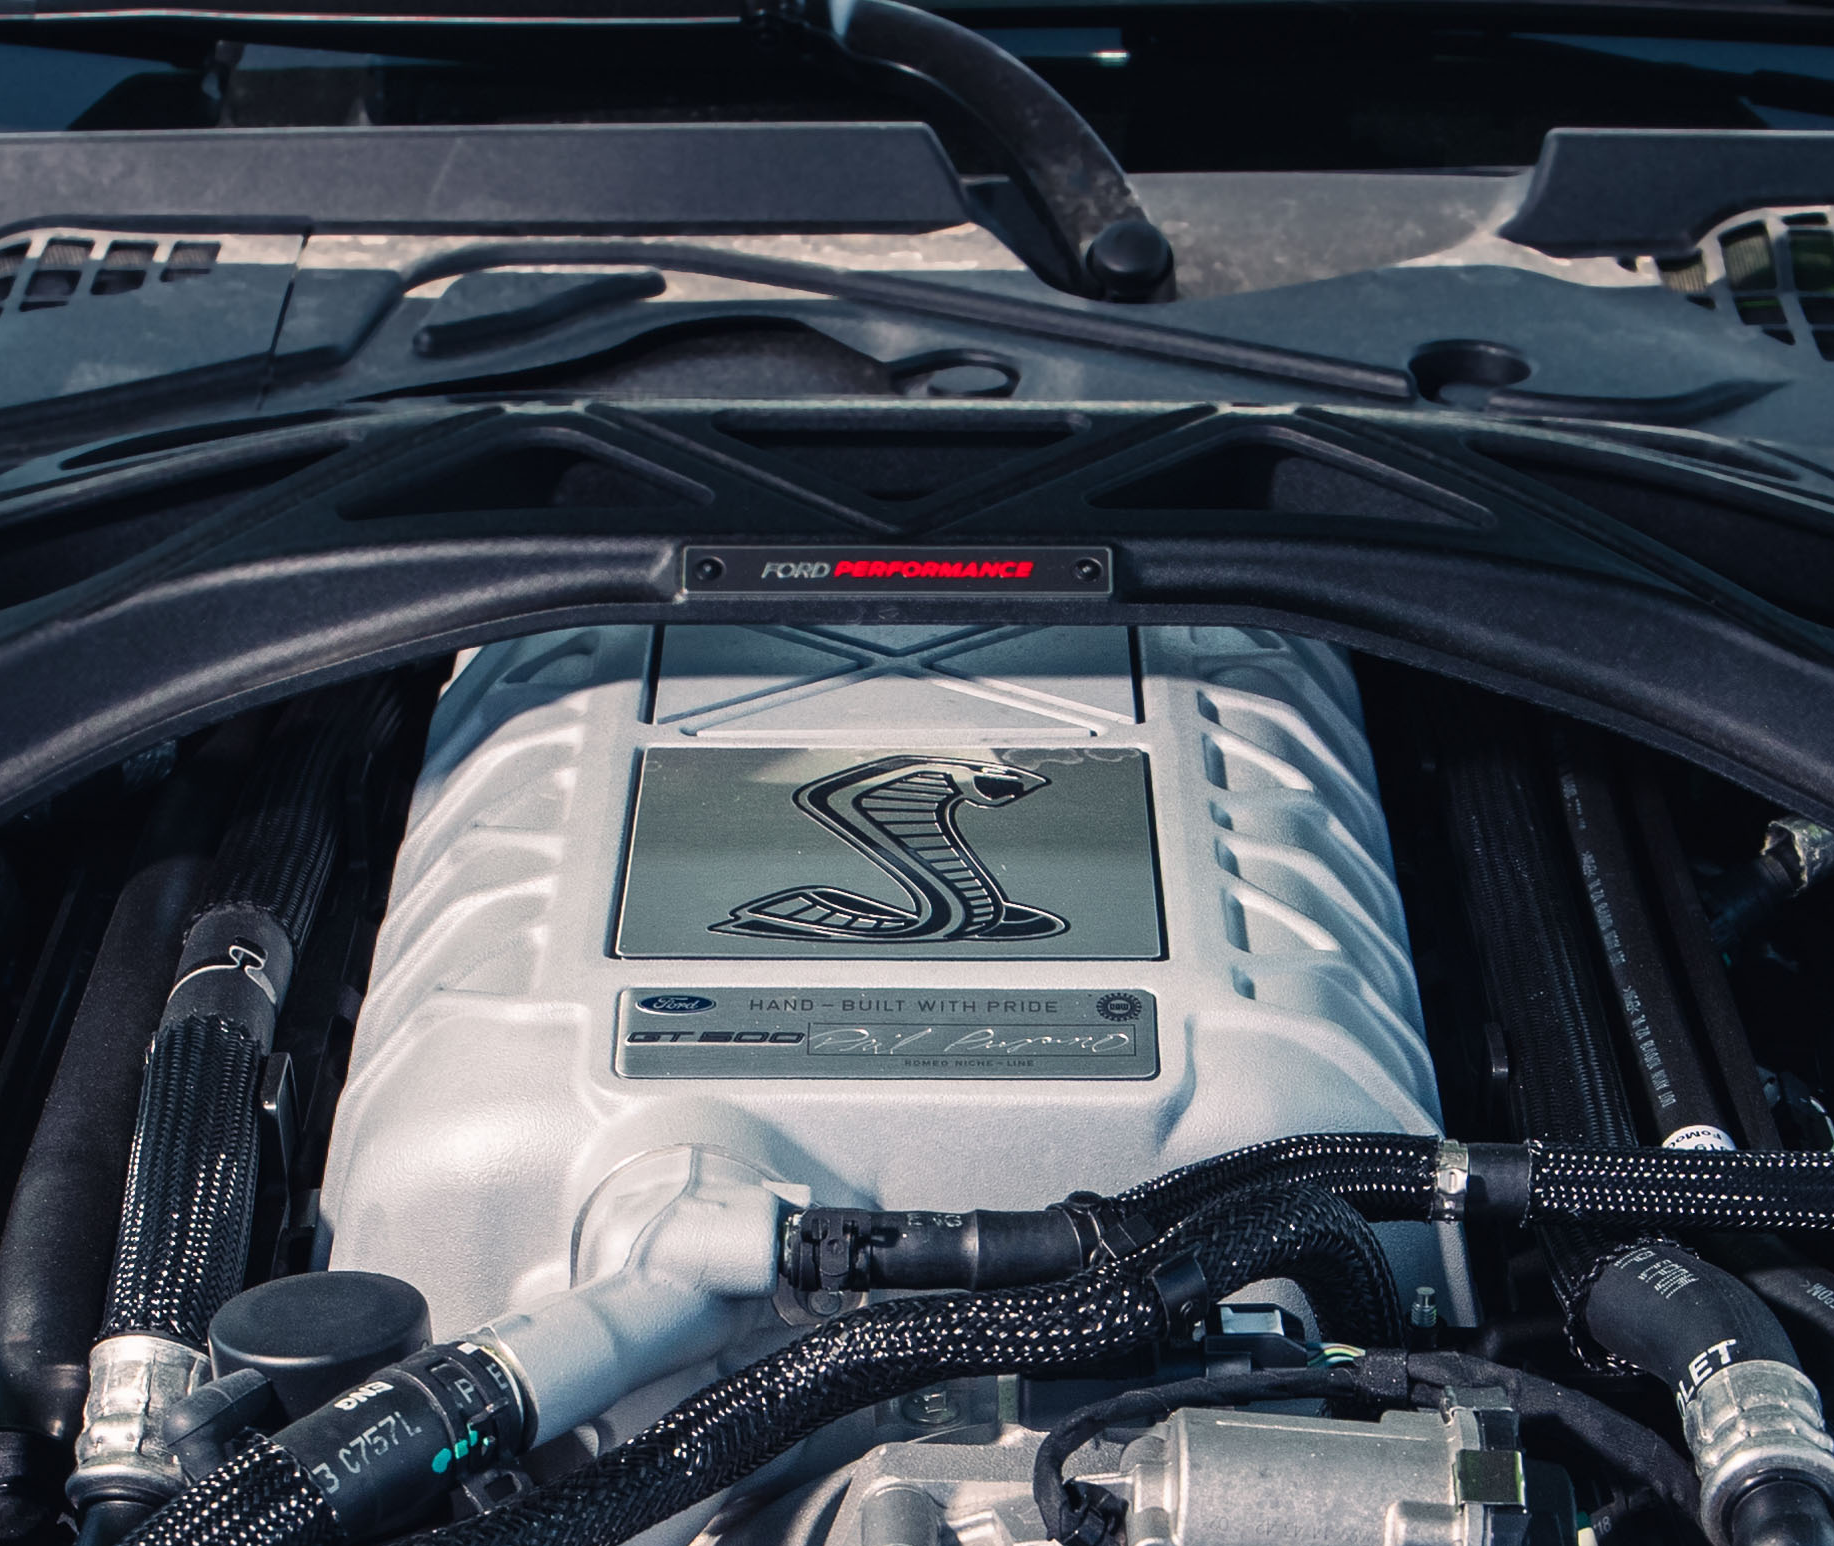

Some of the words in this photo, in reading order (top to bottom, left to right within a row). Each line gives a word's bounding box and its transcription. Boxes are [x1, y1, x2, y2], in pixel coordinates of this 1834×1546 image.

[761, 562, 831, 579] FORD
[833, 560, 1034, 579] PERFORMANCE
[750, 1000, 814, 1012] HAND
[842, 1000, 906, 1013] BUILT
[917, 1000, 977, 1013] WITH
[987, 1000, 1059, 1014] PRIDE
[904, 1060, 949, 1068] ROMEO
[954, 1060, 993, 1068] NICHE
[1007, 1060, 1035, 1068] LINE
[1667, 1130, 1722, 1149] FoMoC
[334, 1380, 395, 1412] ENG
